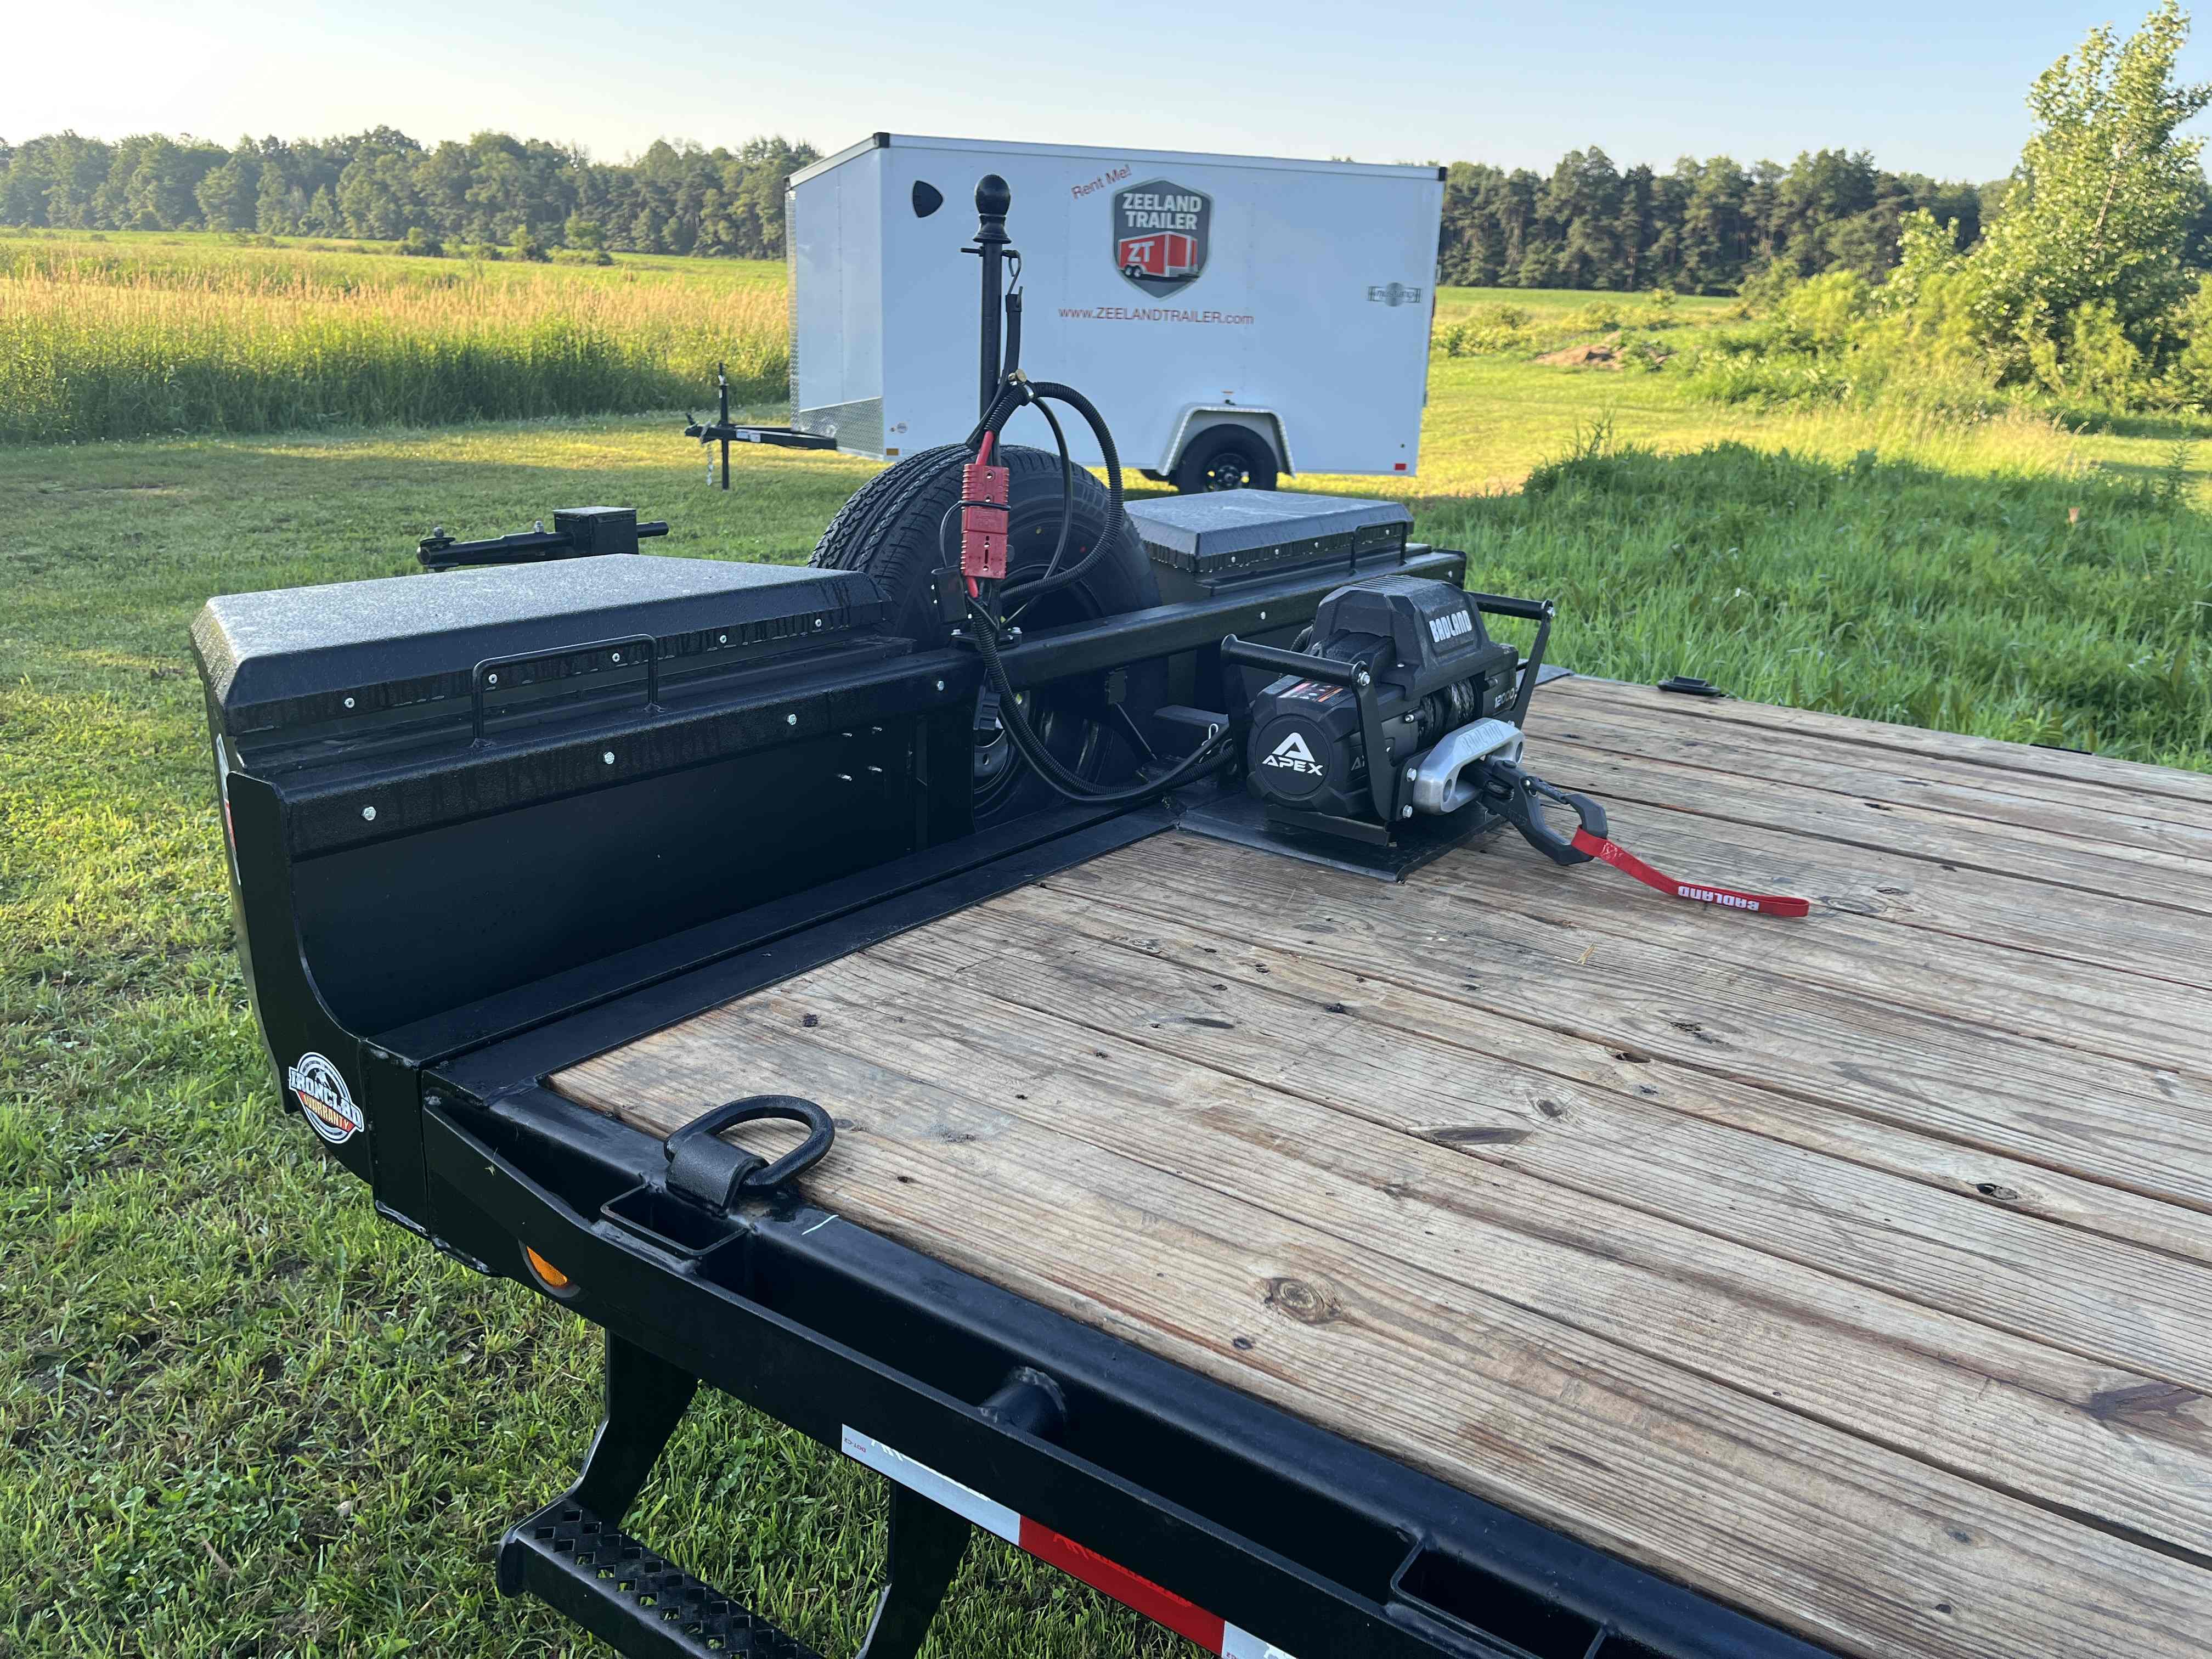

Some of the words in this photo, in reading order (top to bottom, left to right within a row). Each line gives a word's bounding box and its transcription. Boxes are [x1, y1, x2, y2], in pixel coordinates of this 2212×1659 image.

[1071, 177, 1105, 199] Rent
[1105, 164, 1131, 184] Me!
[1122, 193, 1202, 212] ZEELAND
[1125, 211, 1198, 230] TRAILER
[1127, 241, 1155, 263] ZT
[1058, 307, 1254, 325] www.ZEELANDTRAILER.com
[1429, 610, 1472, 642] BADLAND
[1262, 754, 1323, 776] APEX
[1678, 885, 1760, 911] BADLAND
[291, 1070, 362, 1128] IRONCLAD
[303, 1094, 349, 1130] WARRANTY
